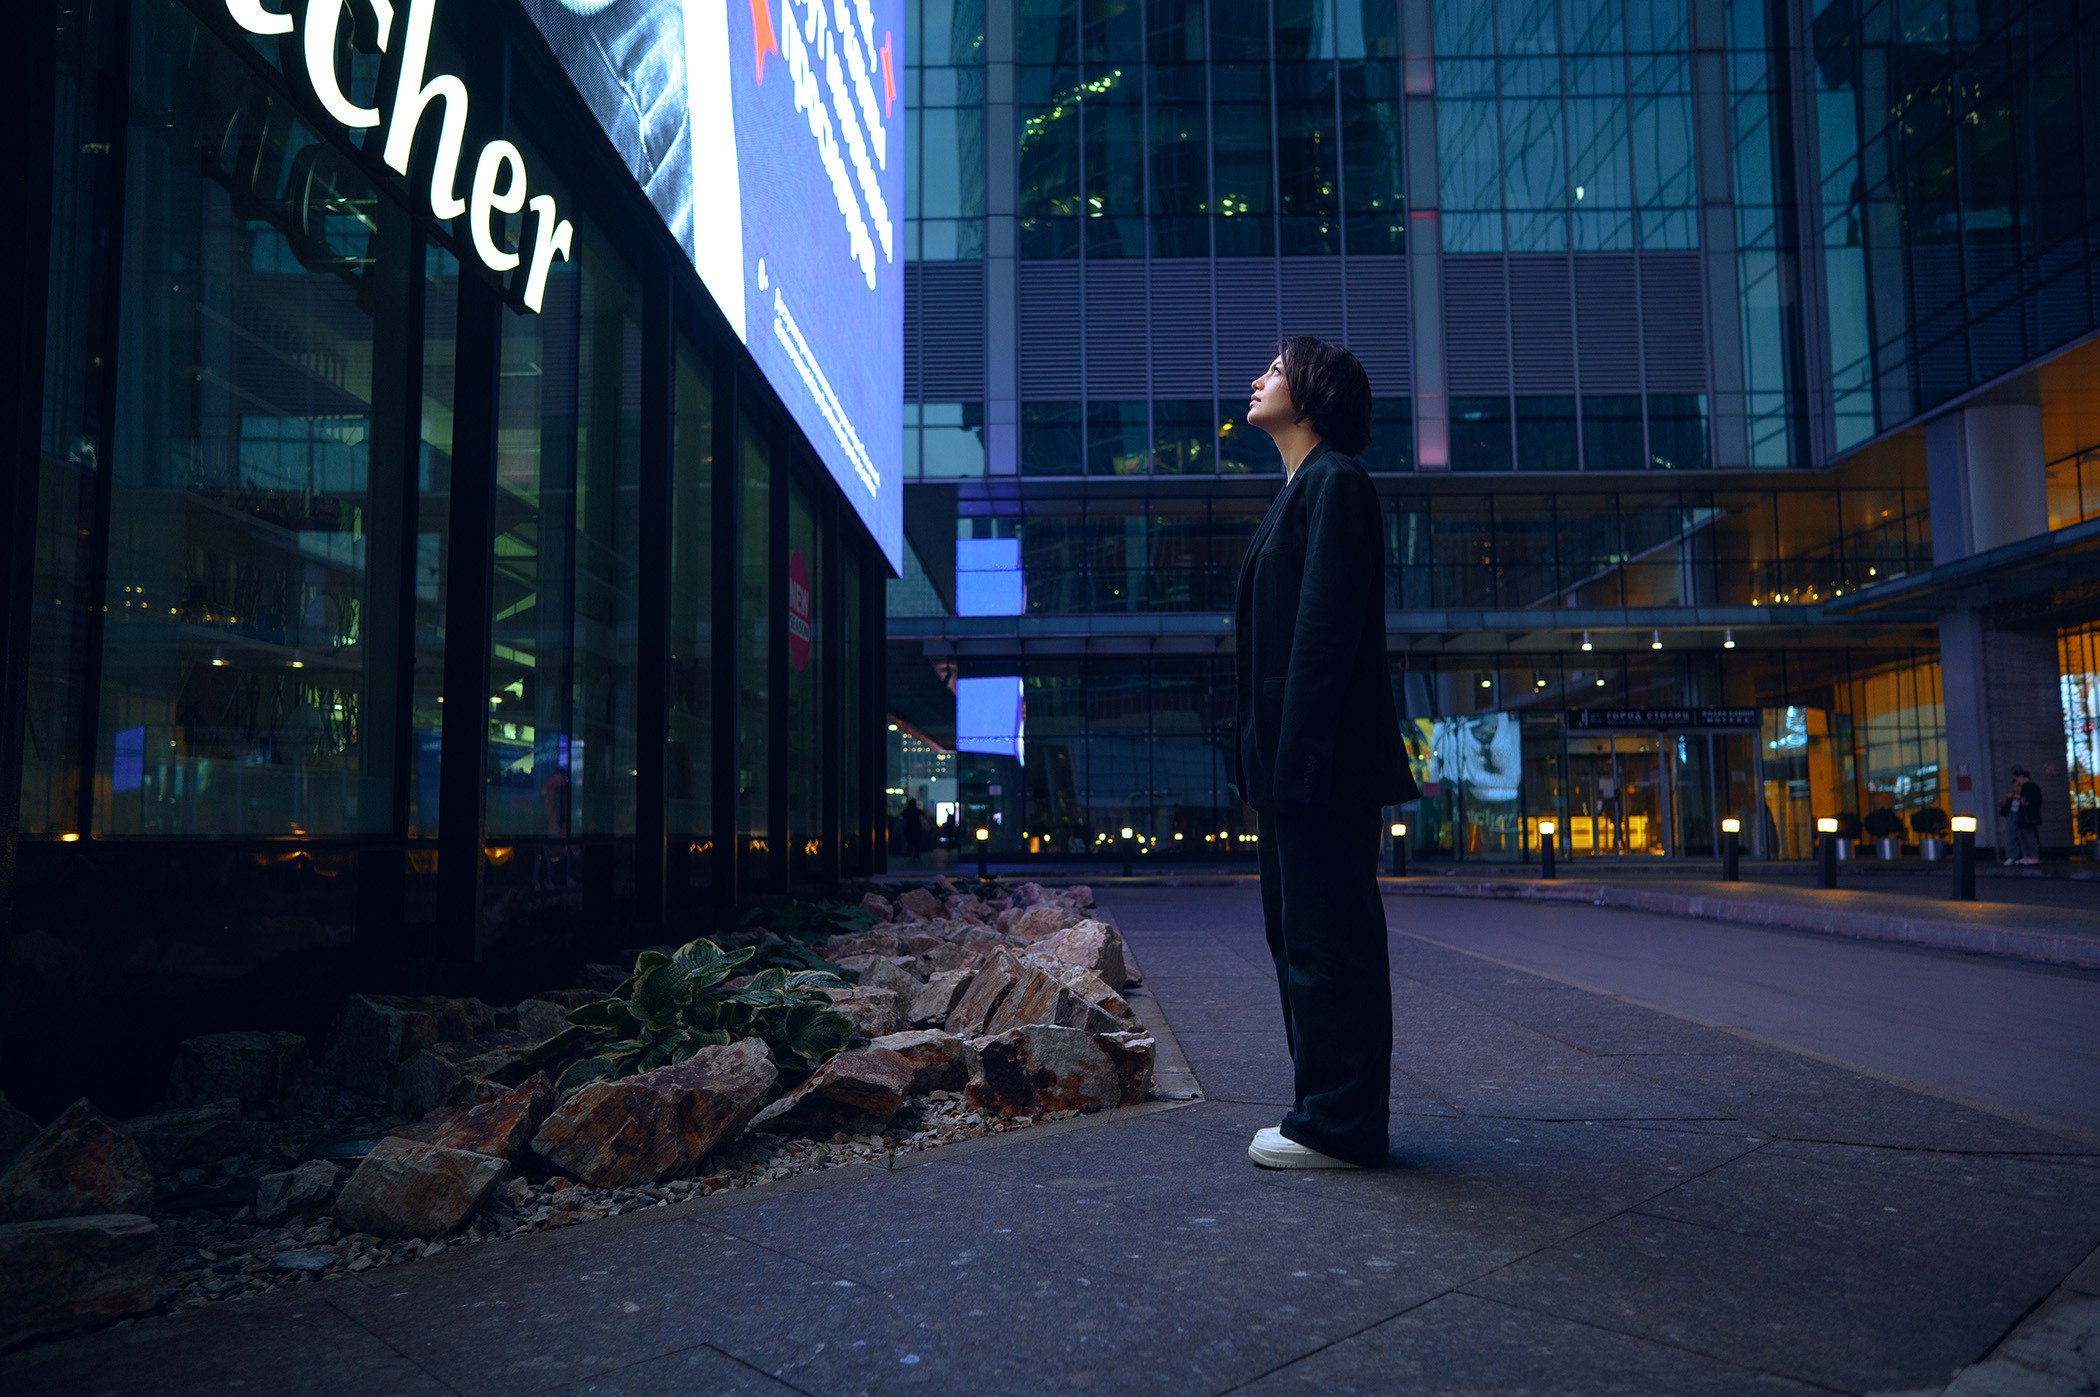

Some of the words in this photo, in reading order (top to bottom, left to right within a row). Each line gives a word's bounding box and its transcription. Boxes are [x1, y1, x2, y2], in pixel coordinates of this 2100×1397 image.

[789, 578, 809, 619] NEW
[789, 614, 809, 640] SEASON
[1606, 711, 1642, 721] ГОРОД
